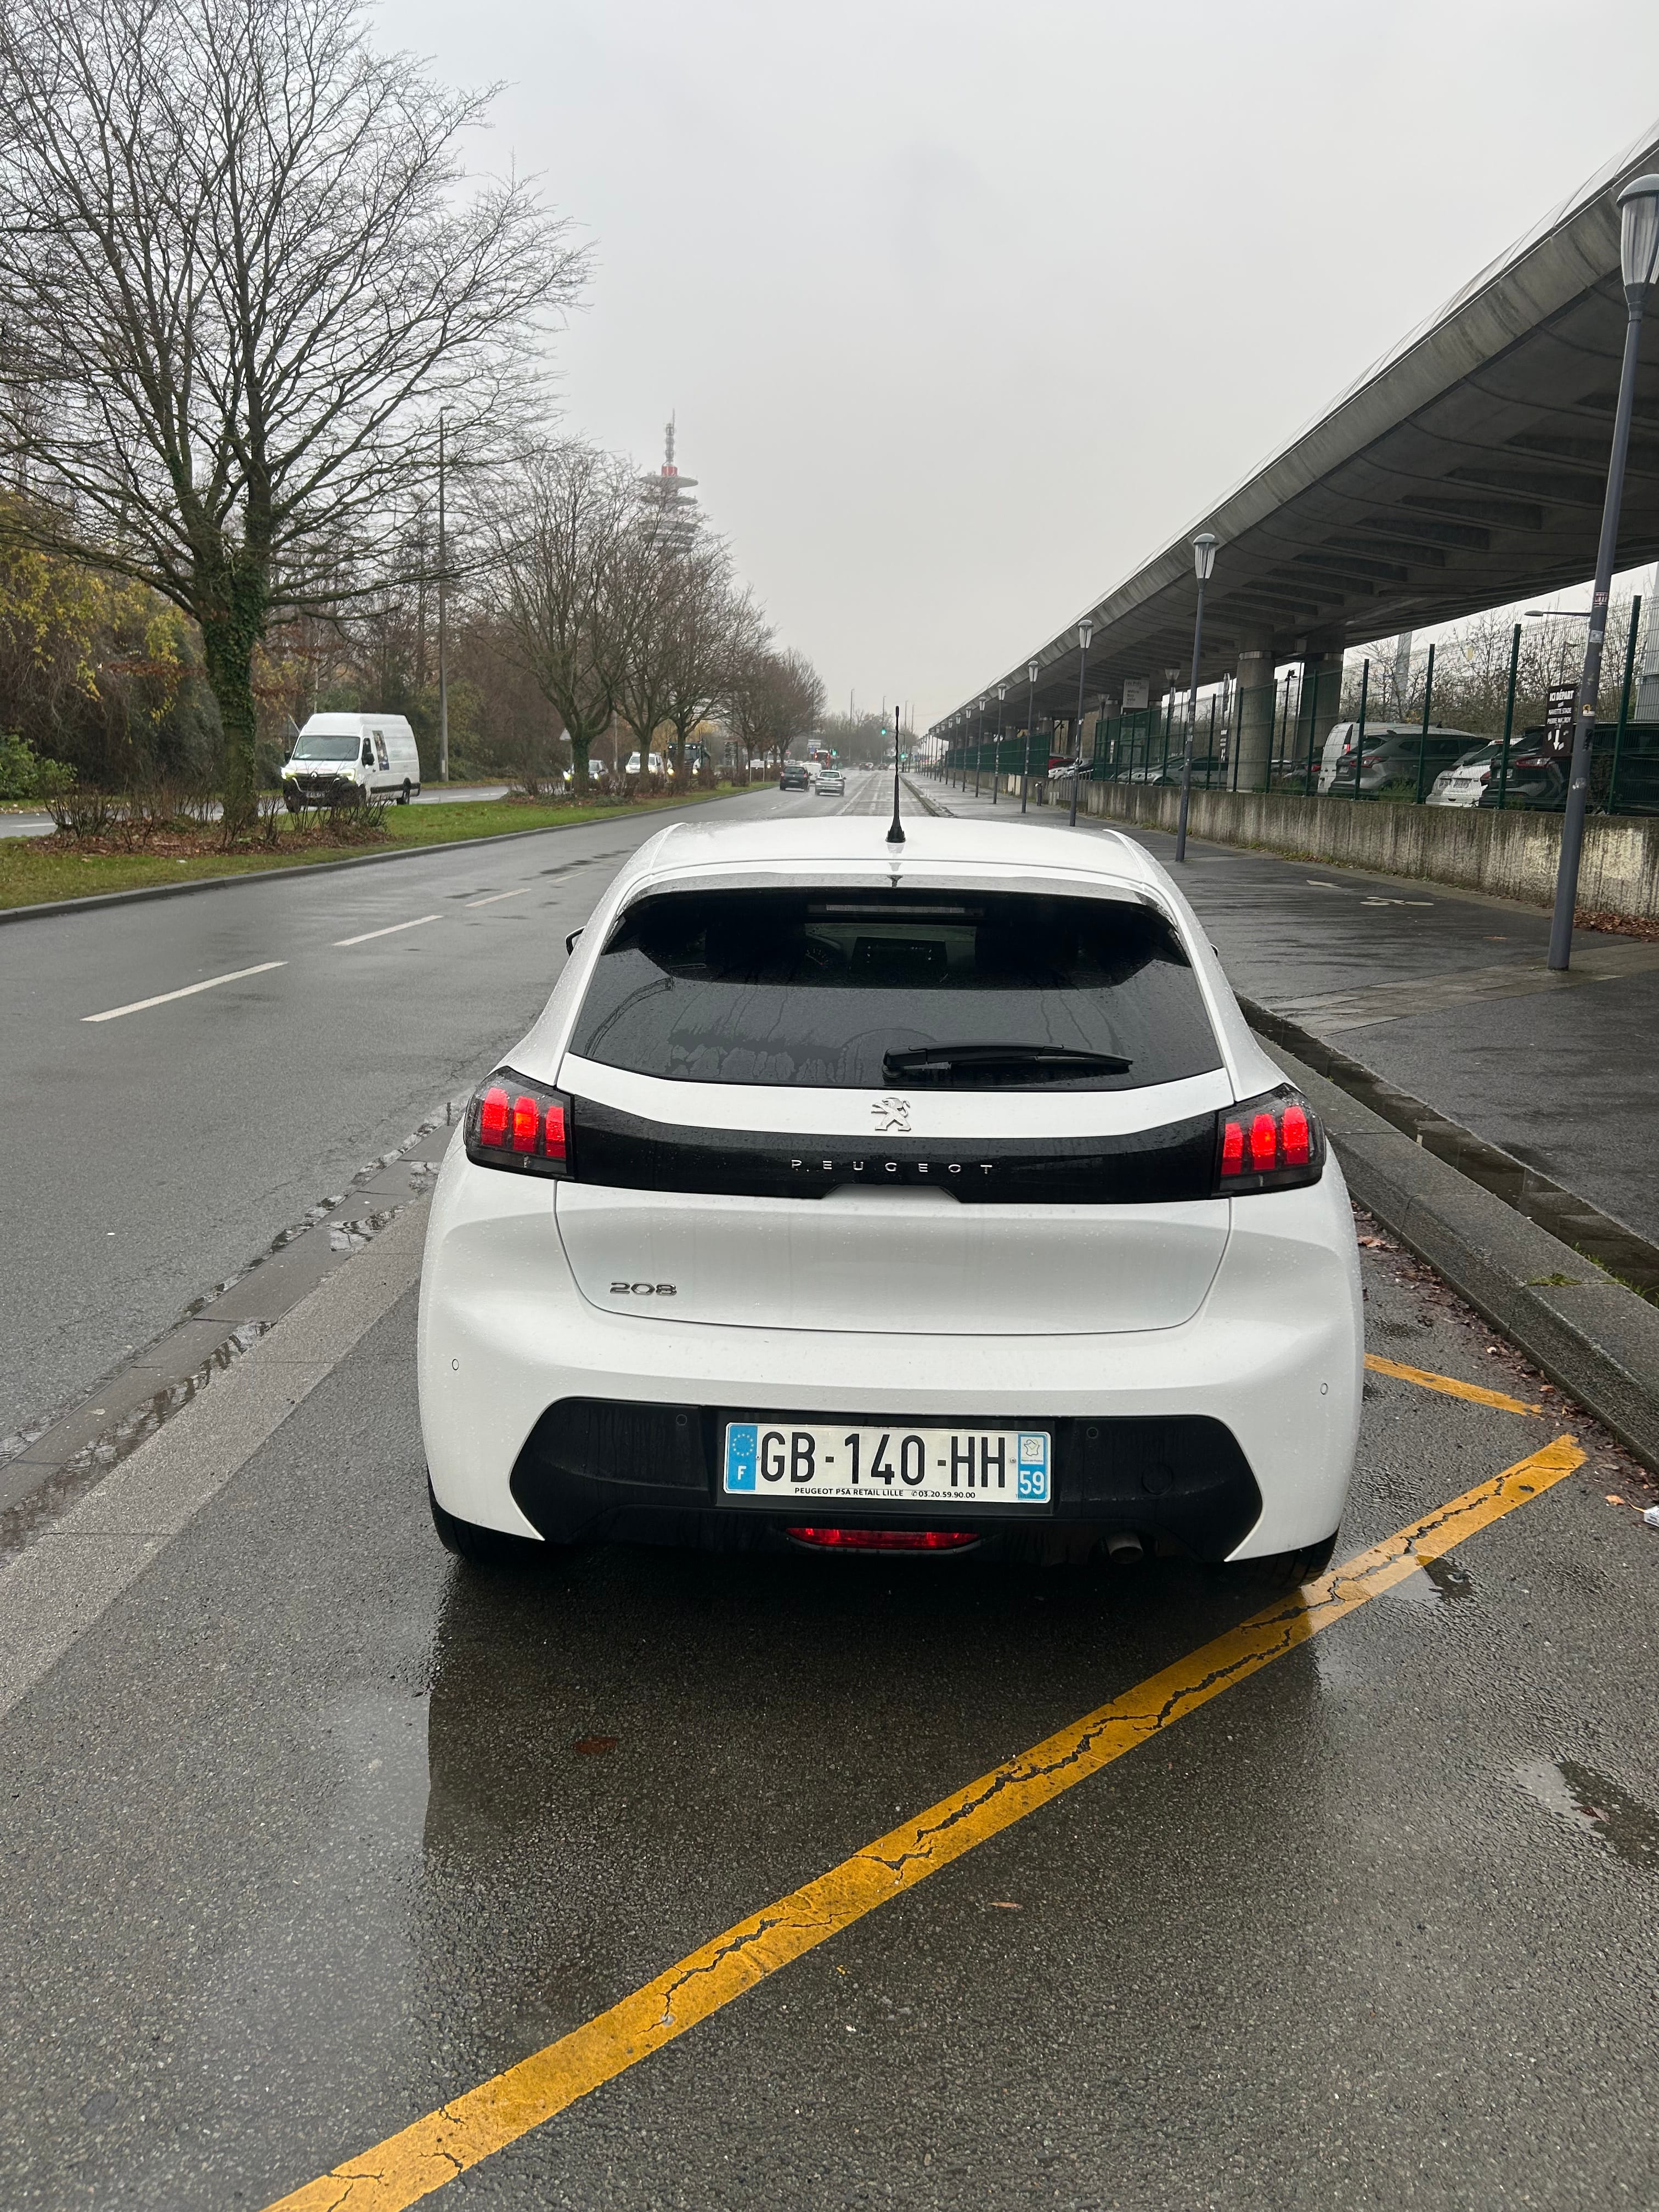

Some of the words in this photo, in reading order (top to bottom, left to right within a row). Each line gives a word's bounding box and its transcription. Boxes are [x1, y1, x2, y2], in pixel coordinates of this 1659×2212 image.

[1556, 689, 1574, 701] DÉPART
[791, 1159, 992, 1174] PEUGEOT
[610, 1282, 677, 1296] 208
[737, 1465, 747, 1480] F
[1020, 1470, 1045, 1494] 59
[918, 1490, 975, 1498] 03.20.59.90.00
